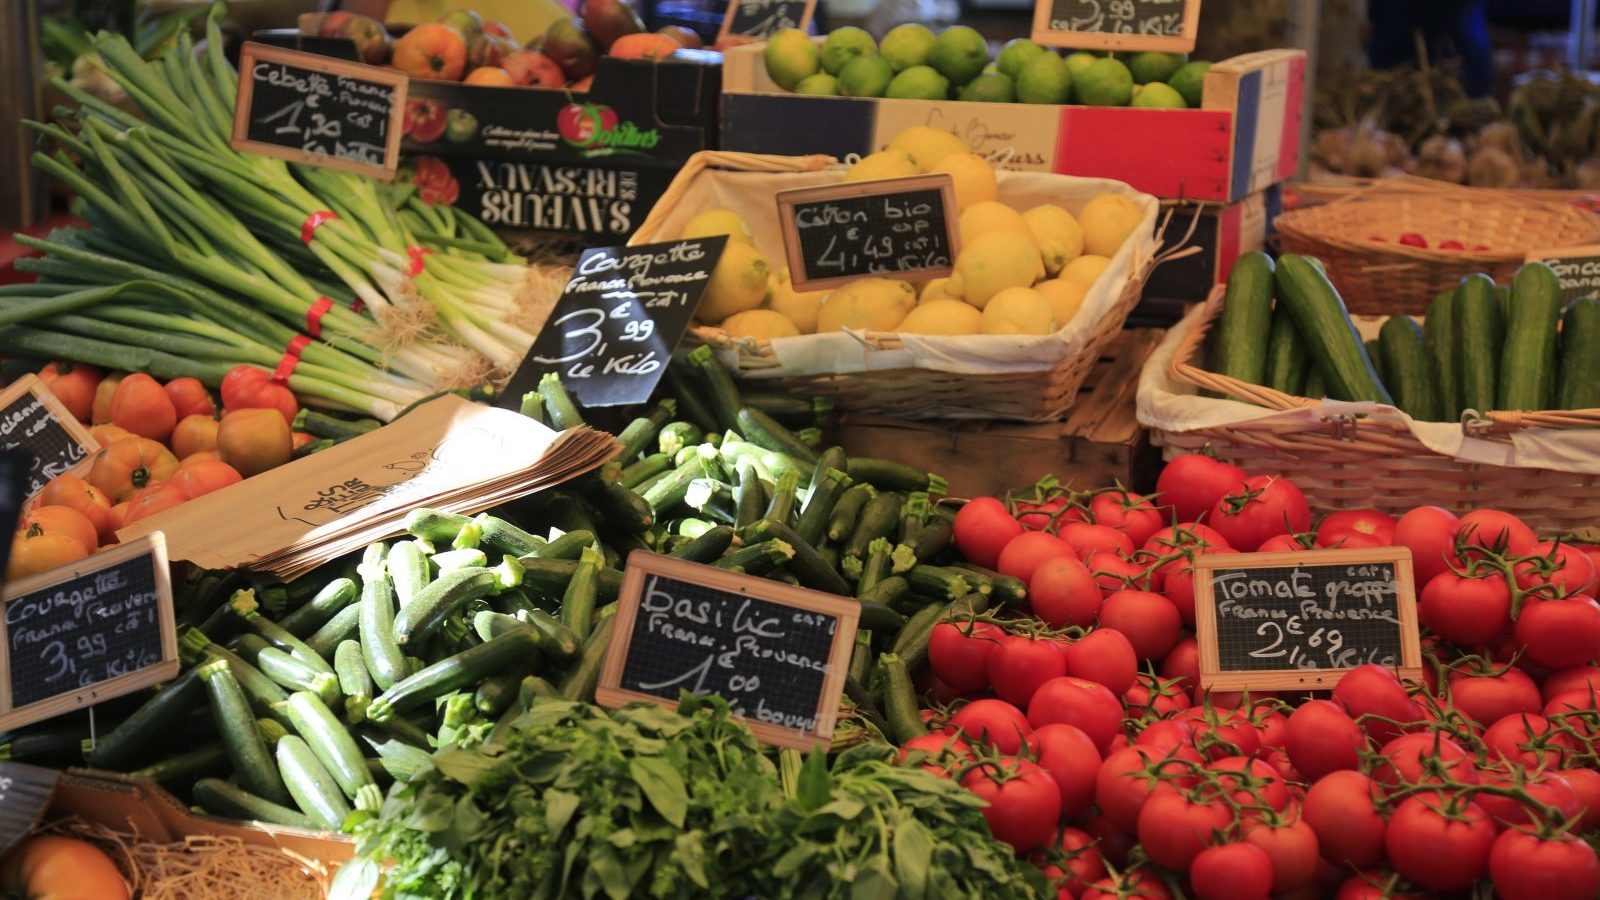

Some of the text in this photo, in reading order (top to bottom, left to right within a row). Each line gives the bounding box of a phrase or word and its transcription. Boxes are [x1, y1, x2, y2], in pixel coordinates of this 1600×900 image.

[480, 189, 631, 233] SAVEURS
[884, 199, 932, 218] bio
[603, 351, 661, 375] Kilo
[1209, 568, 1316, 599] Tomate
[641, 576, 785, 636] basilic
